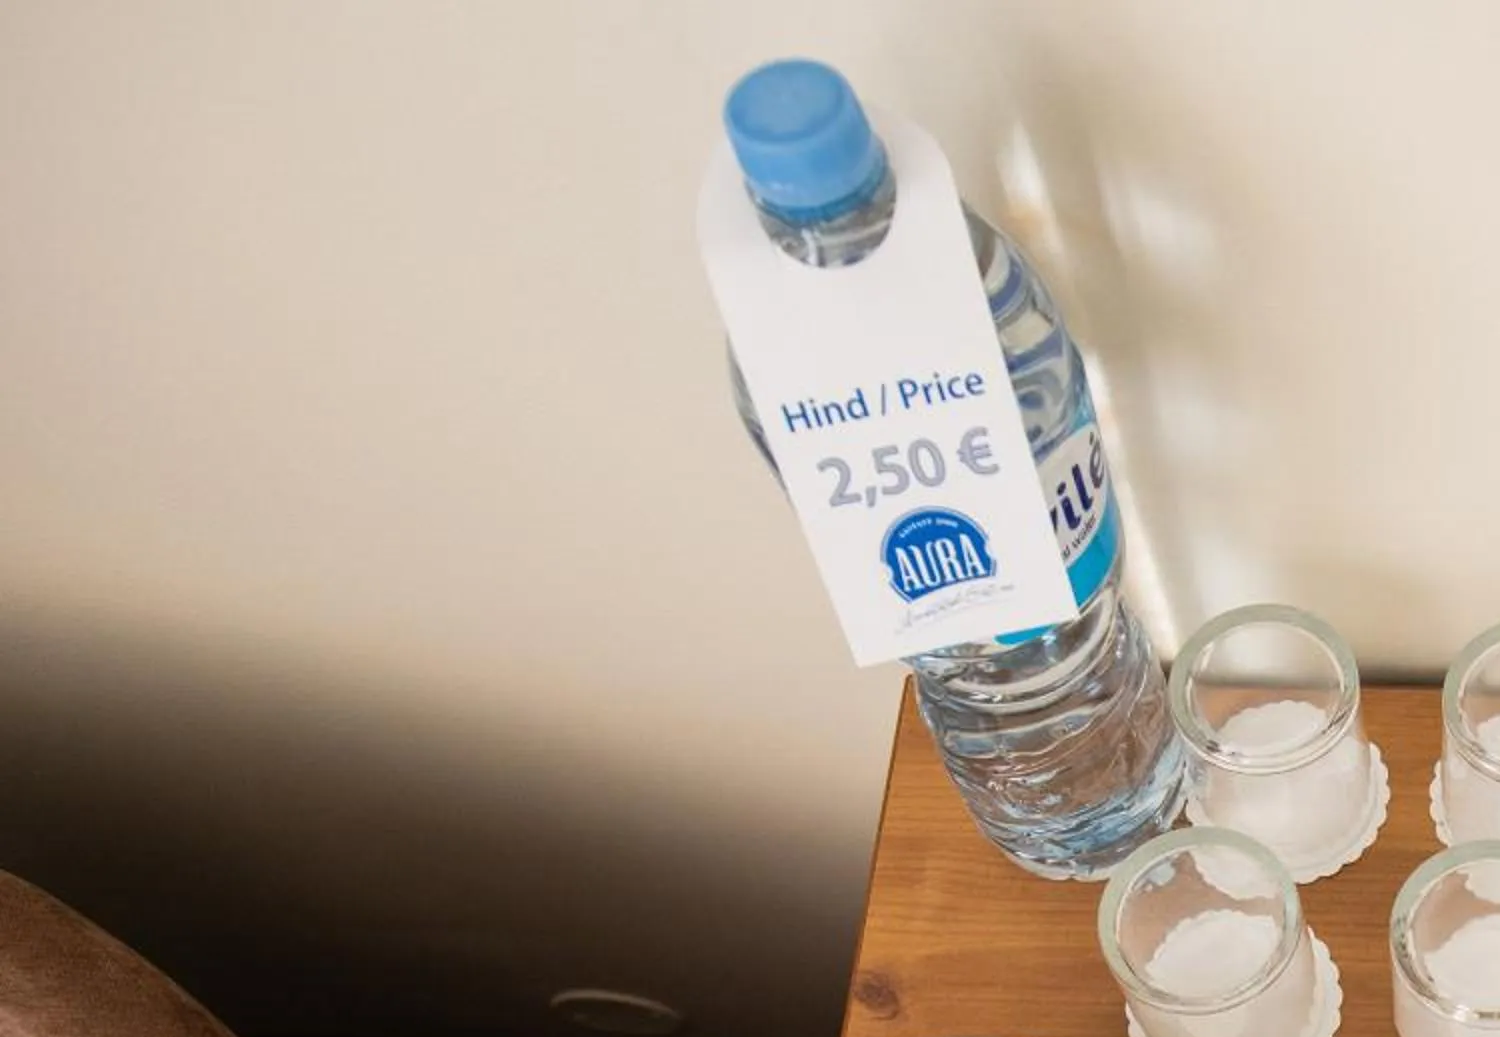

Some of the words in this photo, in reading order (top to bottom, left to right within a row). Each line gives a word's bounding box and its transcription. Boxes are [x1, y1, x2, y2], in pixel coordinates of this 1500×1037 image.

[782, 388, 870, 433] Hind
[880, 384, 886, 416] /
[898, 369, 986, 409] Price
[816, 438, 947, 508] 2,50
[956, 425, 1001, 477] €
[895, 533, 988, 592] AURA
